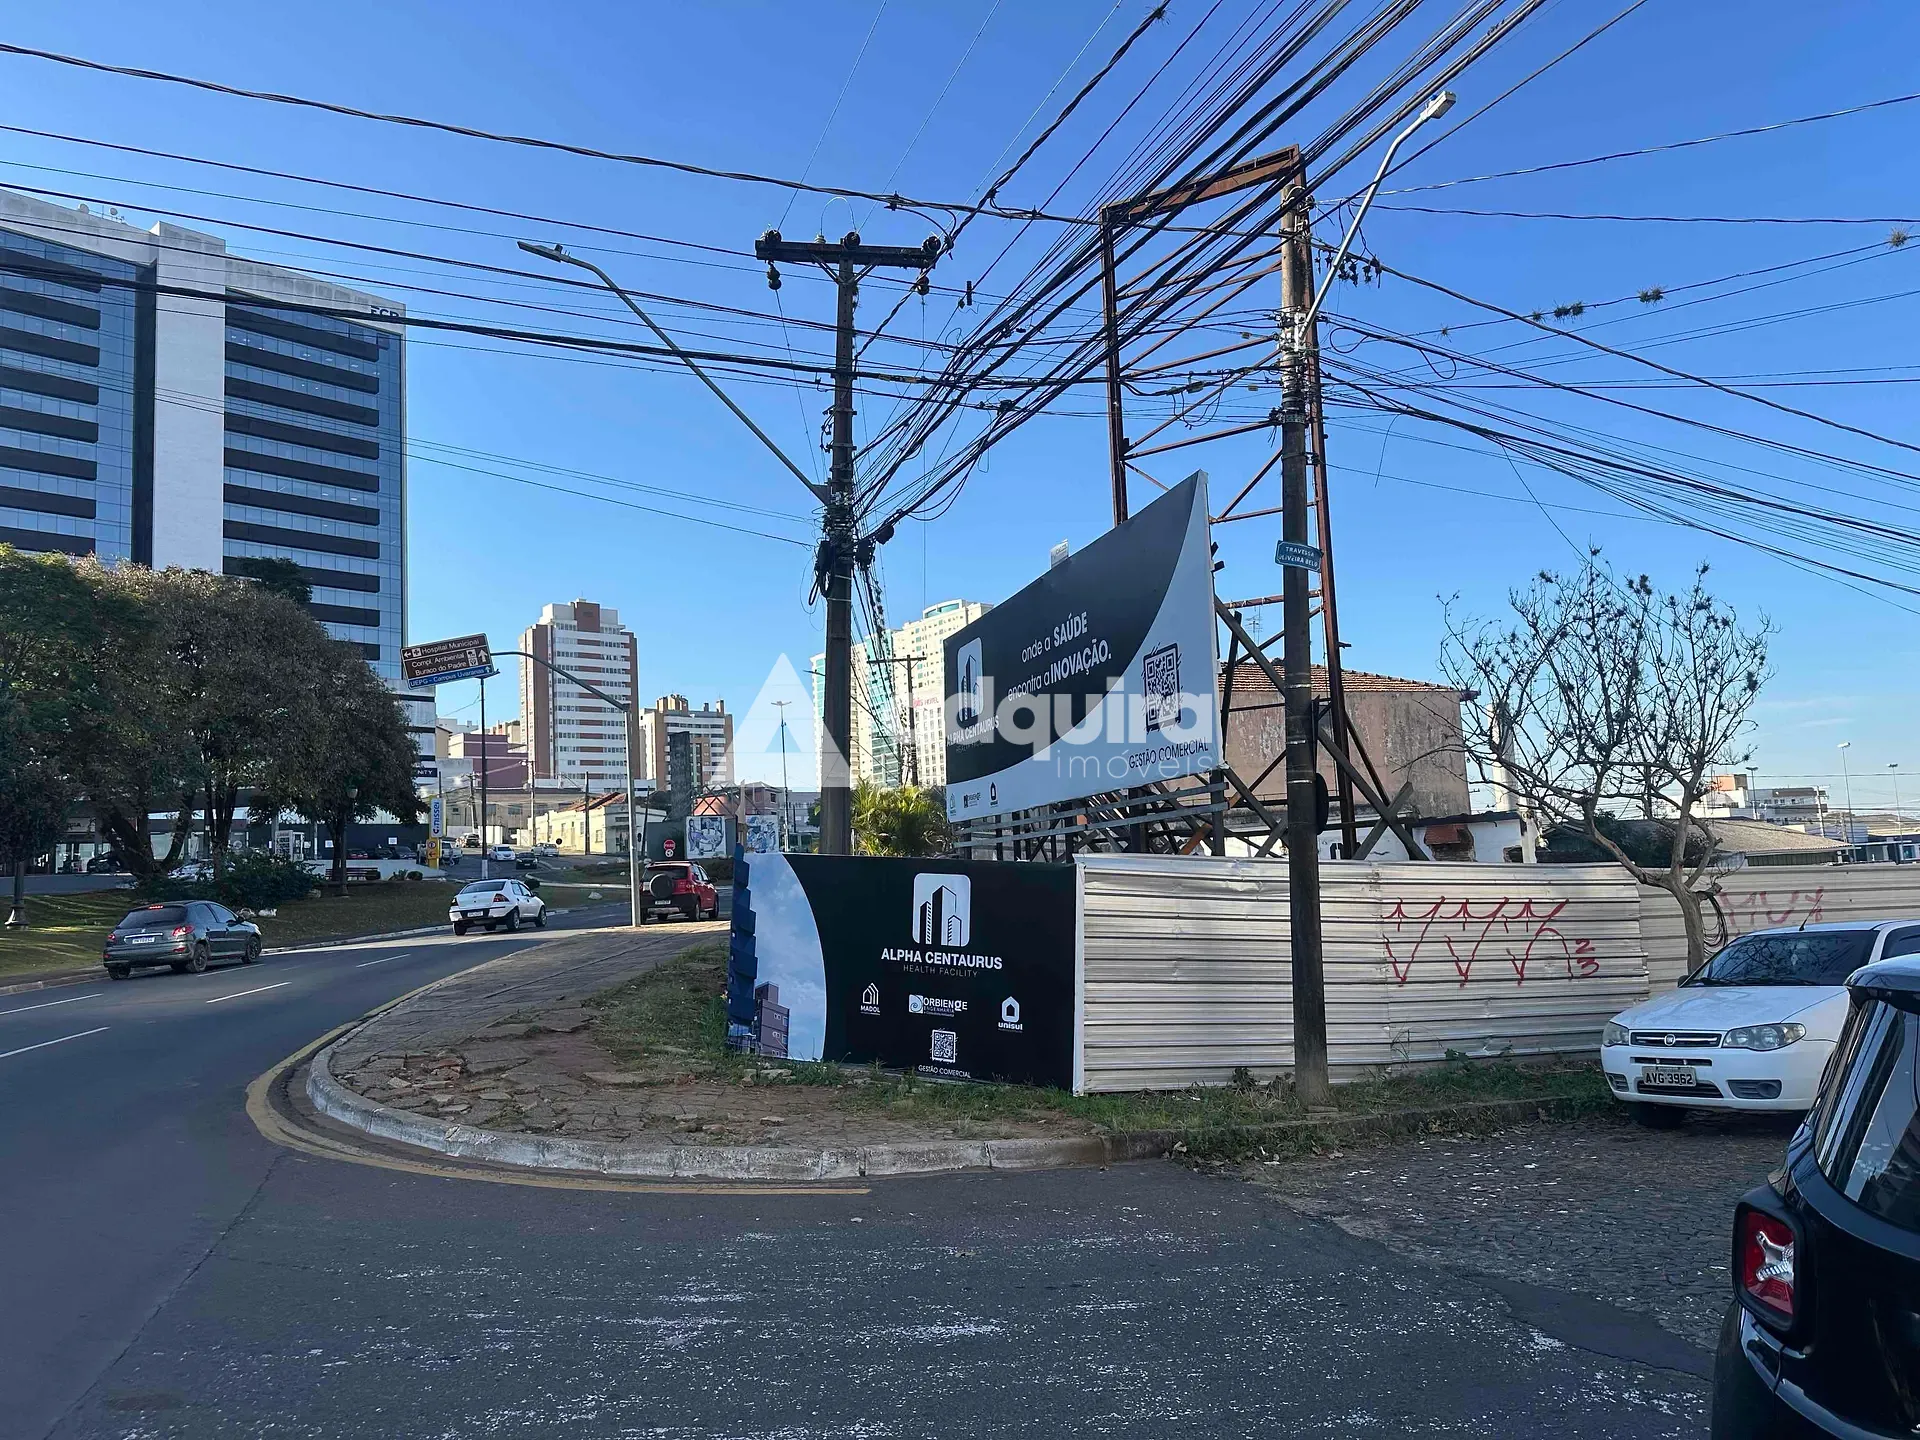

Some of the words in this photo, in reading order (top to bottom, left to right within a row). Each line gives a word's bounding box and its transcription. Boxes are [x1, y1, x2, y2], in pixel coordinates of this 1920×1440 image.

[1286, 547, 1314, 557] TRAVESSA
[1305, 559, 1318, 567] BELO
[1022, 640, 1043, 663] onde
[1044, 637, 1051, 651] a
[1053, 611, 1088, 647] SAÚDE
[421, 644, 448, 655] Hospital
[448, 638, 480, 649] Municipal
[434, 652, 465, 663] Ambiental
[415, 667, 438, 676] Buraco
[447, 660, 467, 669] Padre
[1008, 675, 1042, 701] encontra
[1044, 671, 1050, 686] a
[1050, 638, 1112, 684] INOVAÇÃO.
[433, 674, 457, 682] Campus
[947, 731, 964, 747] ALPHA
[965, 715, 1000, 740] CENTAURUS
[1129, 749, 1157, 769] GESTÃO
[1158, 738, 1208, 761] COMERCIAL
[881, 948, 922, 963] ALPHA
[925, 951, 1003, 970] CENTAURUS
[903, 964, 936, 974] HEALTH
[939, 967, 979, 977] FACILITY
[998, 1021, 1023, 1030] unisul
[918, 1064, 938, 1074] GESTÃO
[939, 1067, 972, 1079] COMERCIAL
